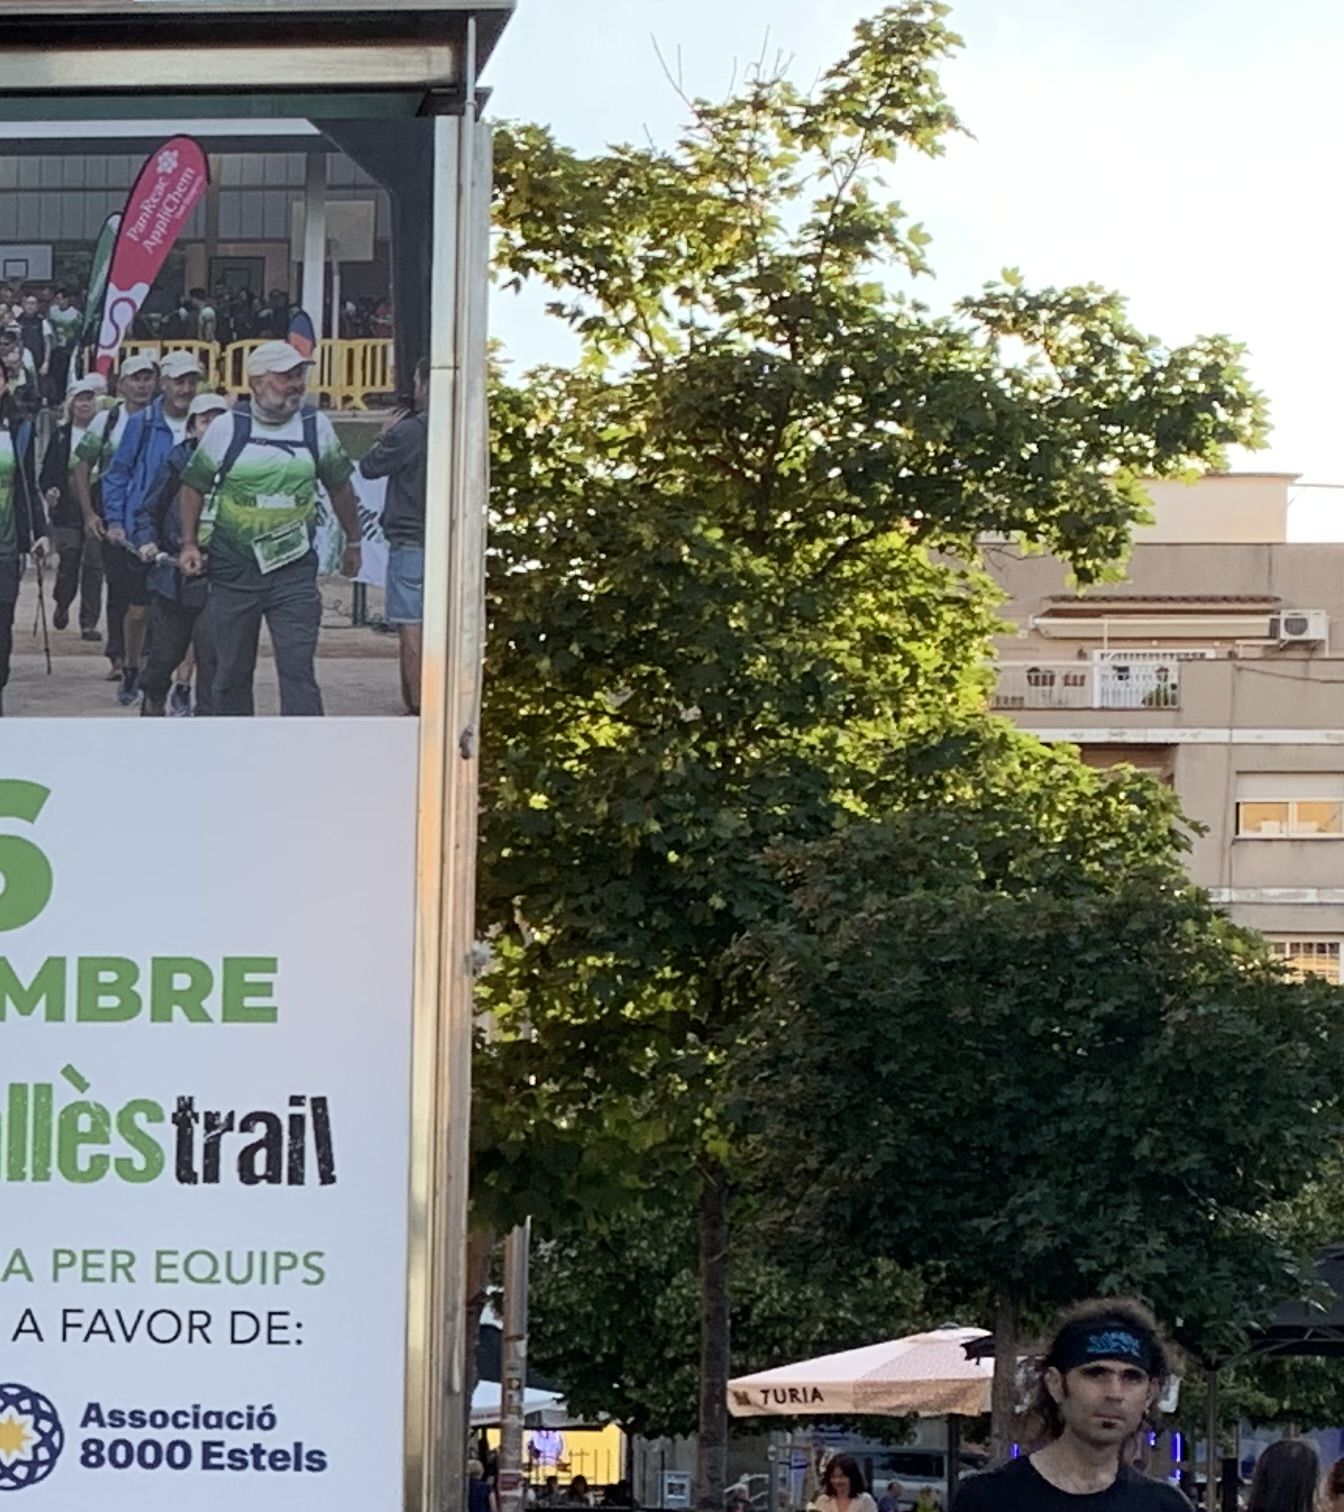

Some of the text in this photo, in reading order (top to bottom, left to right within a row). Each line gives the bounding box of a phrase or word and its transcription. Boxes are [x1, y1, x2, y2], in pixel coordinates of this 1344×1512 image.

[142, 167, 195, 255] AppliChem
[51, 1248, 137, 1284] PER
[154, 1249, 326, 1286] EQUIPS
[11, 1308, 45, 1343] A
[61, 1308, 213, 1345] FAVOR
[229, 1310, 304, 1346] DE:
[760, 1387, 825, 1405] TURIA
[79, 1402, 278, 1432] Associació
[79, 1438, 329, 1474] 8000 Estels
